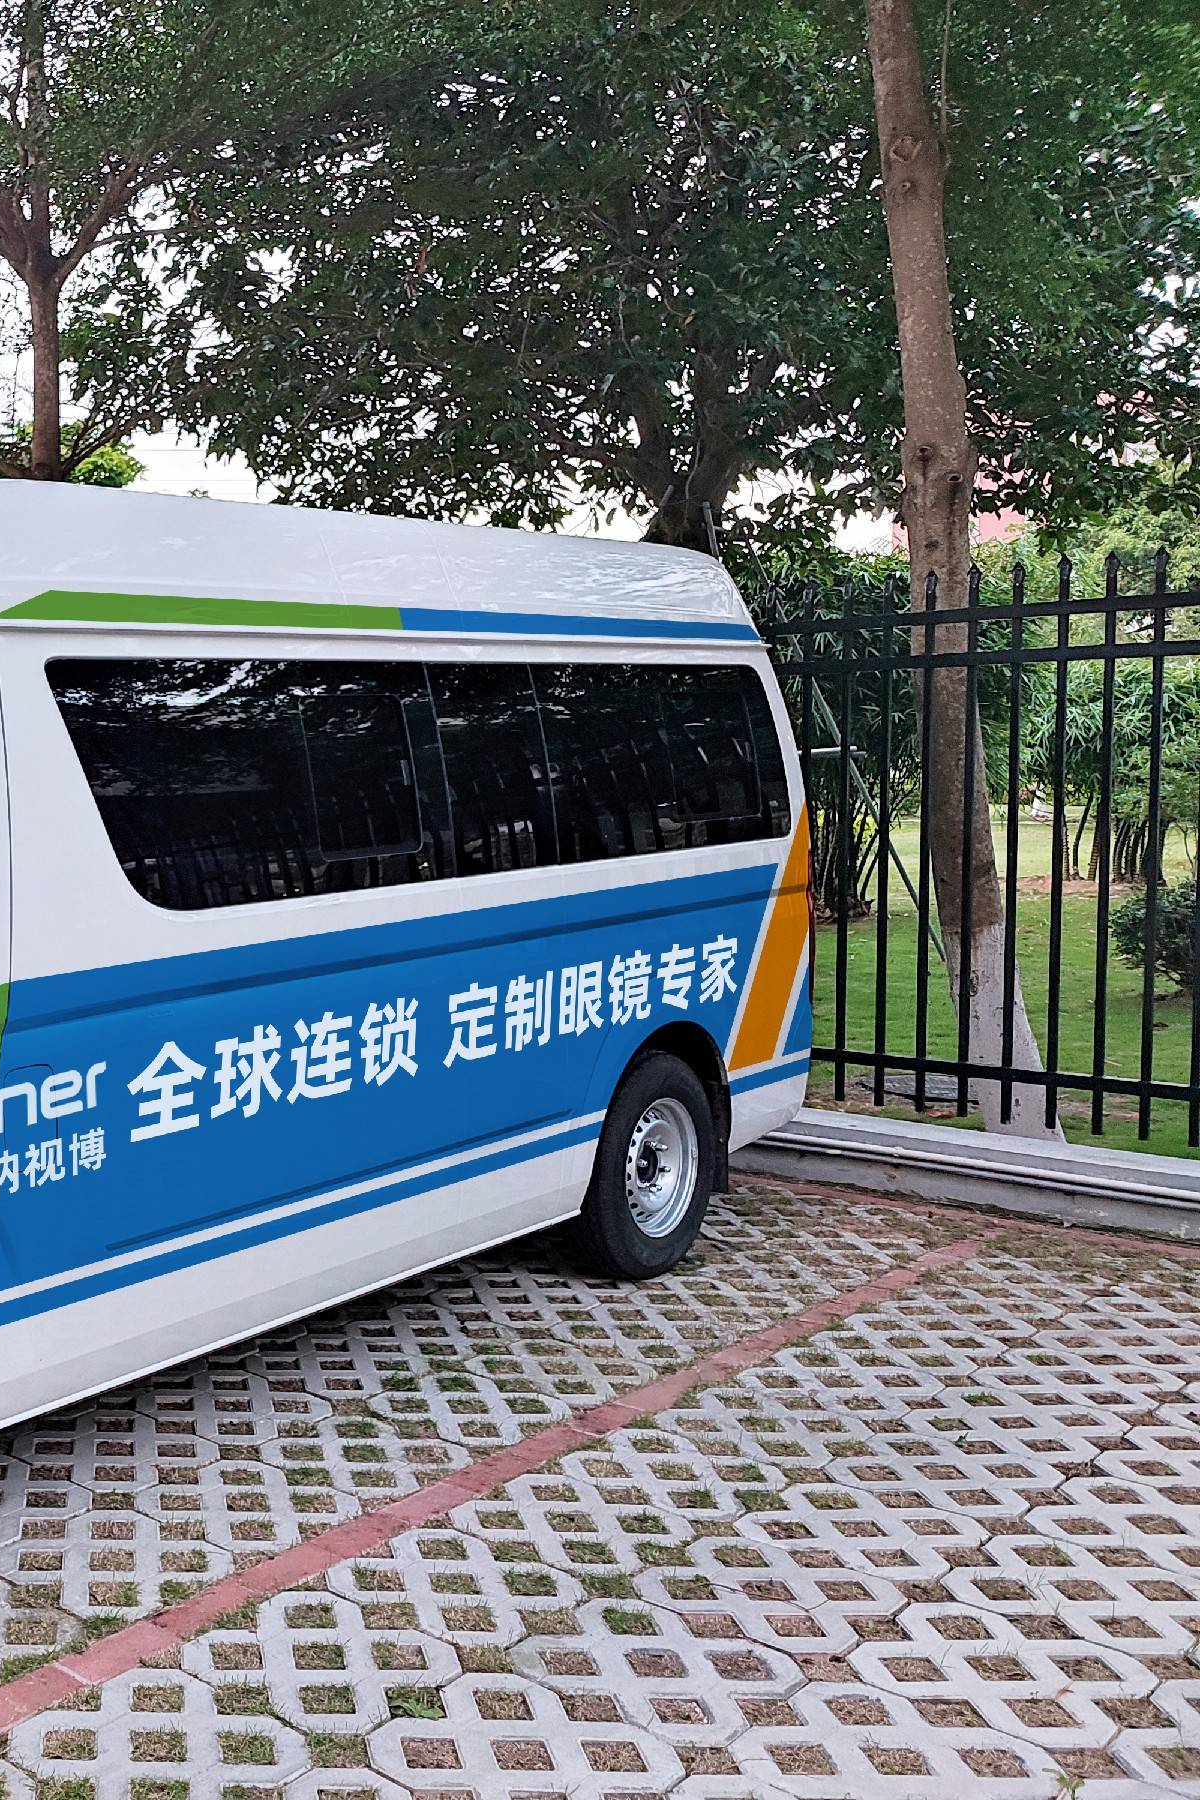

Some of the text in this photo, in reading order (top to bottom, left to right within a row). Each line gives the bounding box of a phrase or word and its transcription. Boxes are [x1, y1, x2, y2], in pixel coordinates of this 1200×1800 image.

[127, 934, 740, 1143] 全球连锁 定制眼镜专家
